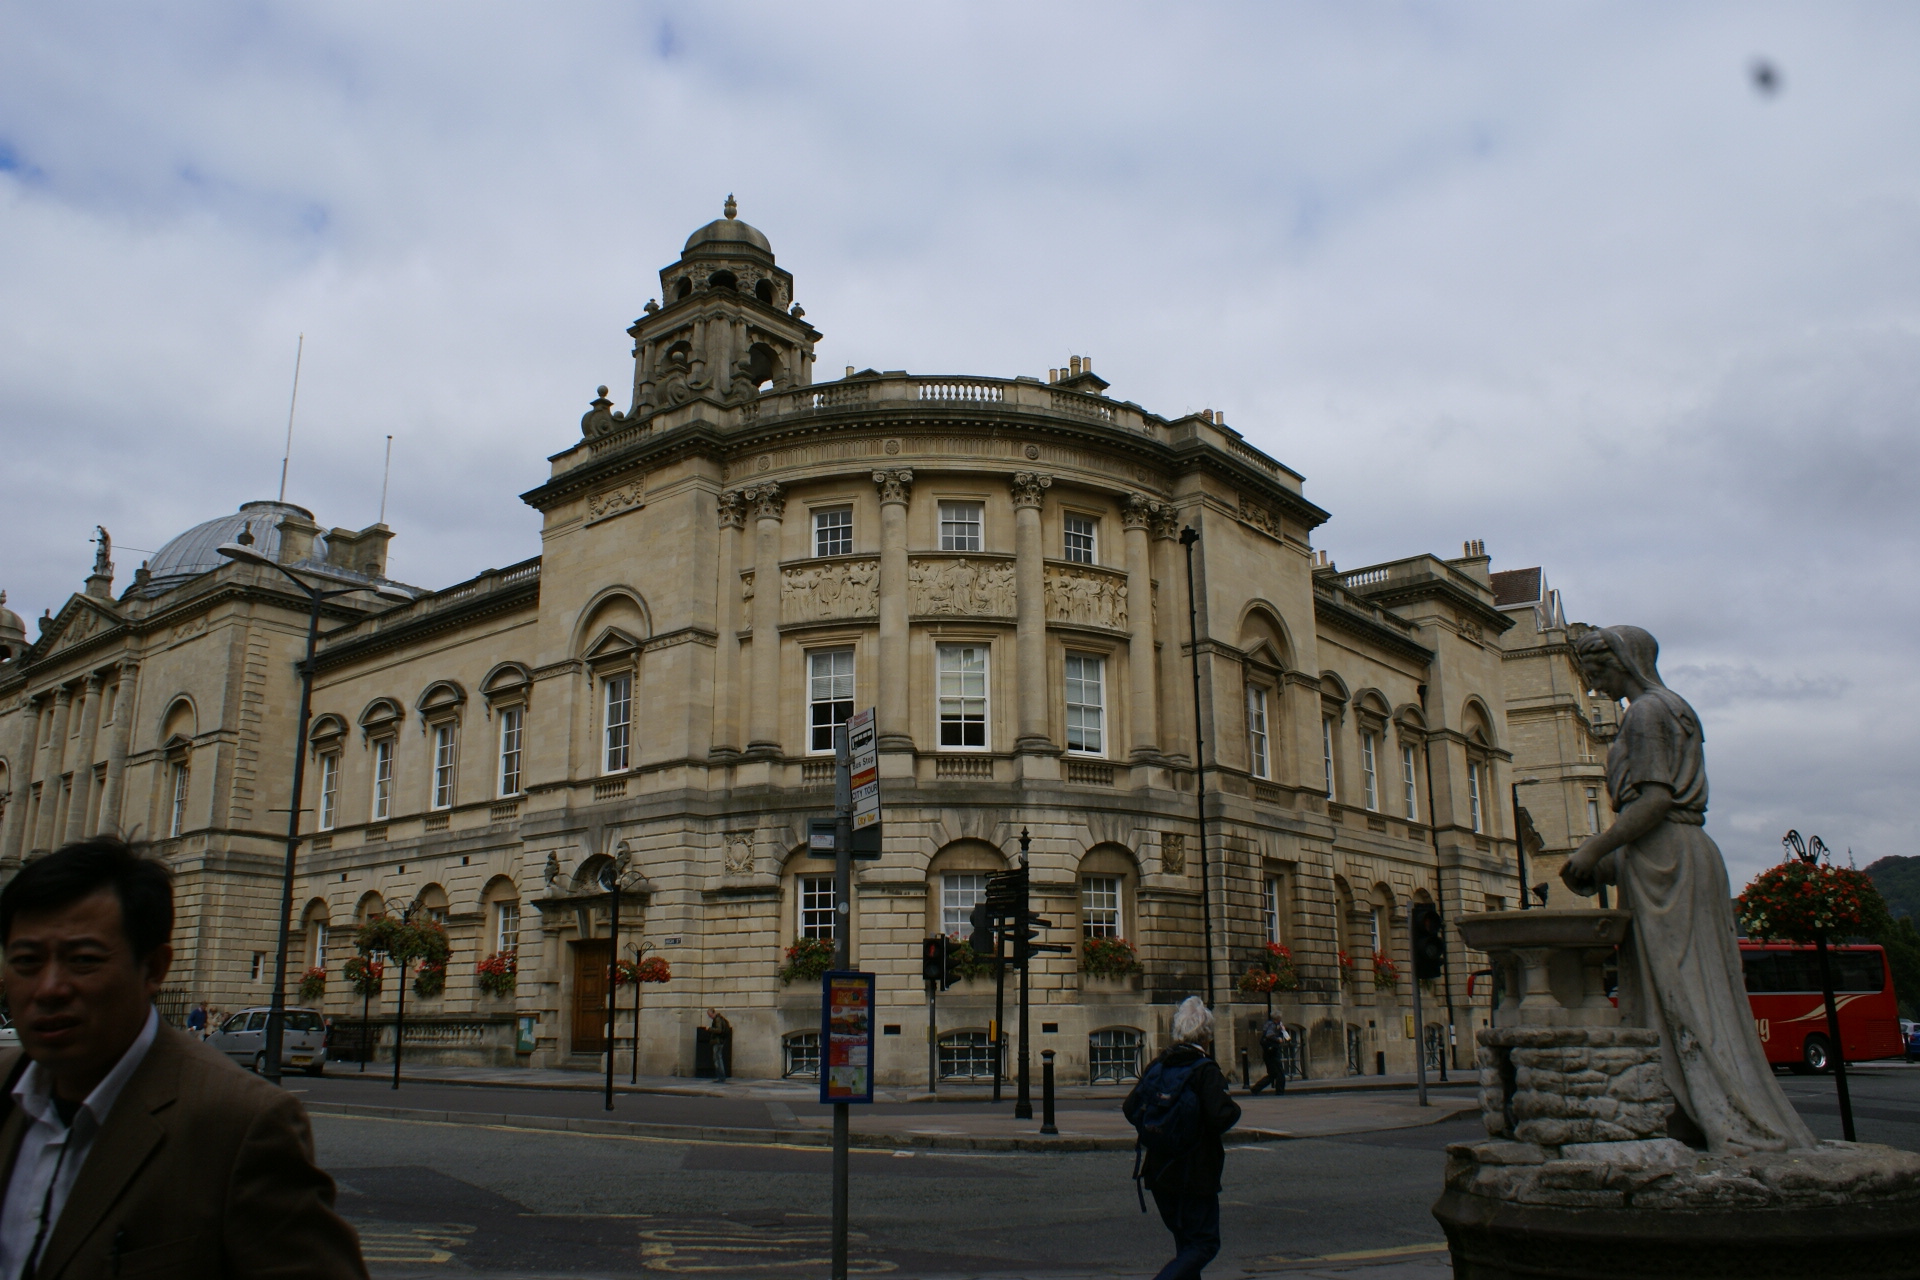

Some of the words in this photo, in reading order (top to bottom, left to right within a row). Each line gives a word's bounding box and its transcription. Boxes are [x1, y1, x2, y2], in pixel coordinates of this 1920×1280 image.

[852, 761, 862, 770] Bus
[862, 756, 874, 766] Stop
[852, 789, 863, 800] CITY
[864, 783, 878, 795] TOUR
[857, 816, 866, 826] City
[866, 812, 876, 822] Tour
